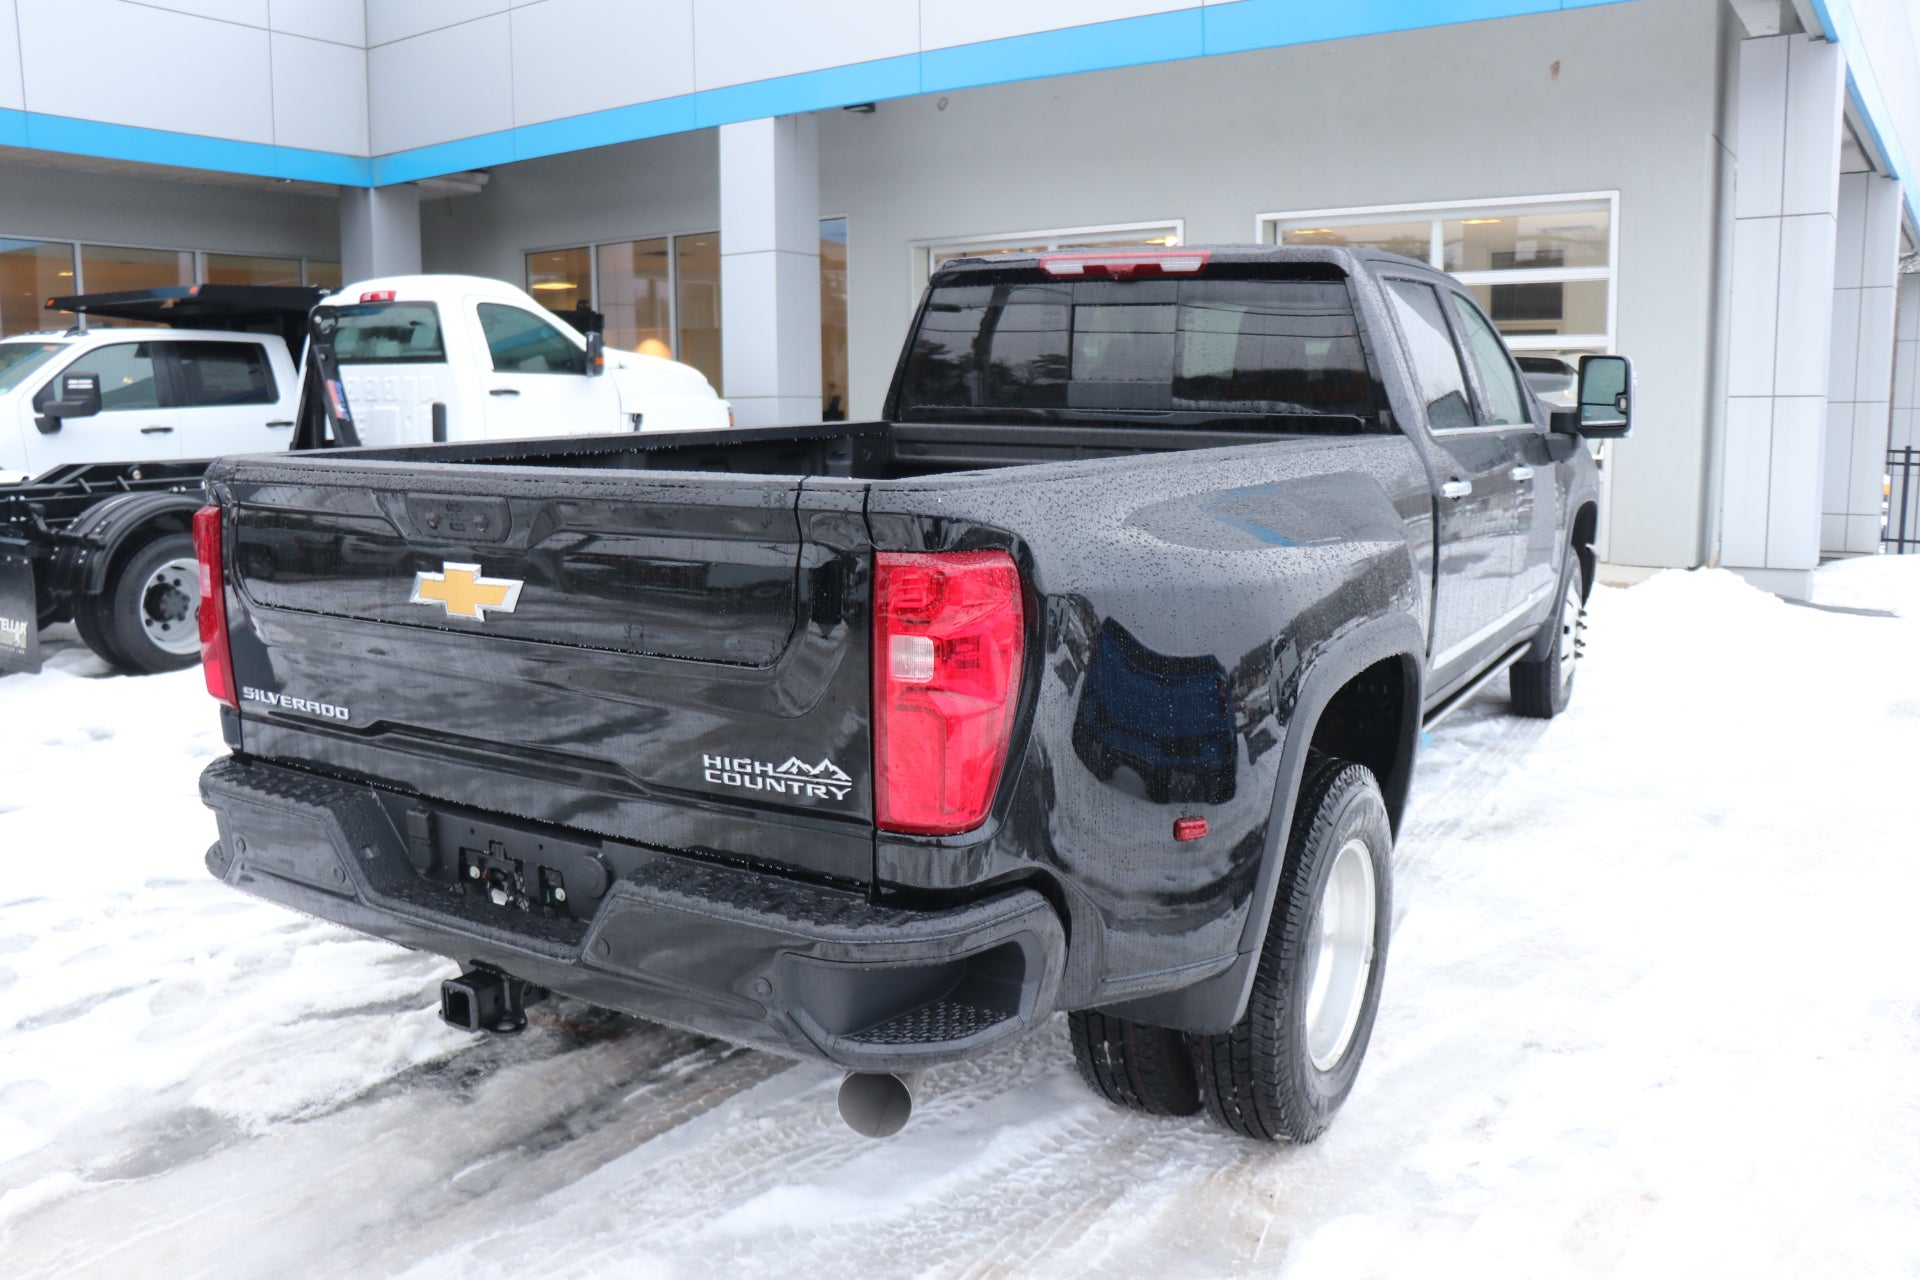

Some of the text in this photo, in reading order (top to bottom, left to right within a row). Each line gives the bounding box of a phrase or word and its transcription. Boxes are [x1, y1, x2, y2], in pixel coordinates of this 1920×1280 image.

[242, 686, 350, 721] SILVERADO
[703, 754, 774, 776] HIGH
[704, 769, 852, 801] COUNTRY
